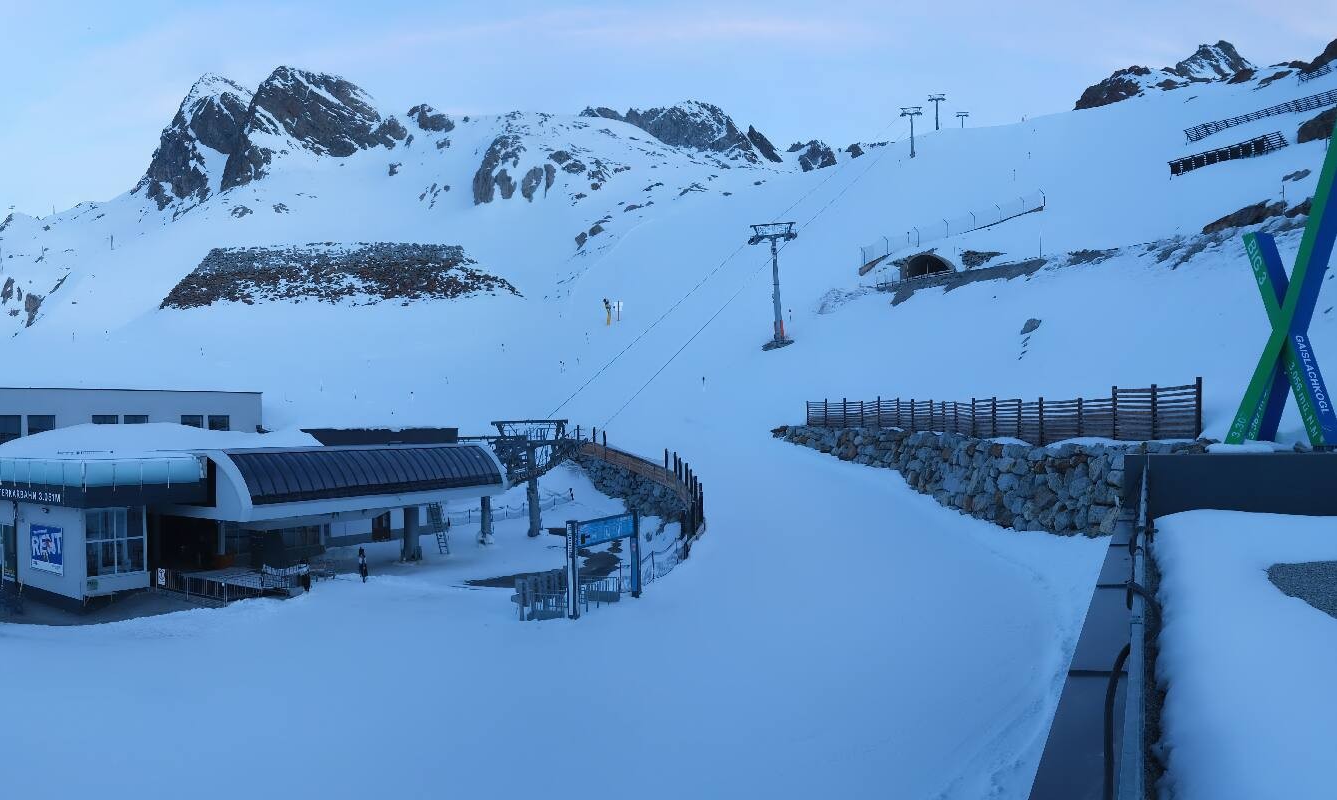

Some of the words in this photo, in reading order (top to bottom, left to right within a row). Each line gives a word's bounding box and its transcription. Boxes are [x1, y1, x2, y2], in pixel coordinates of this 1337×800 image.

[1247, 239, 1262, 272] BIG
[1258, 272, 1267, 286] 3
[1295, 334, 1331, 416] GAISLACHKOGL
